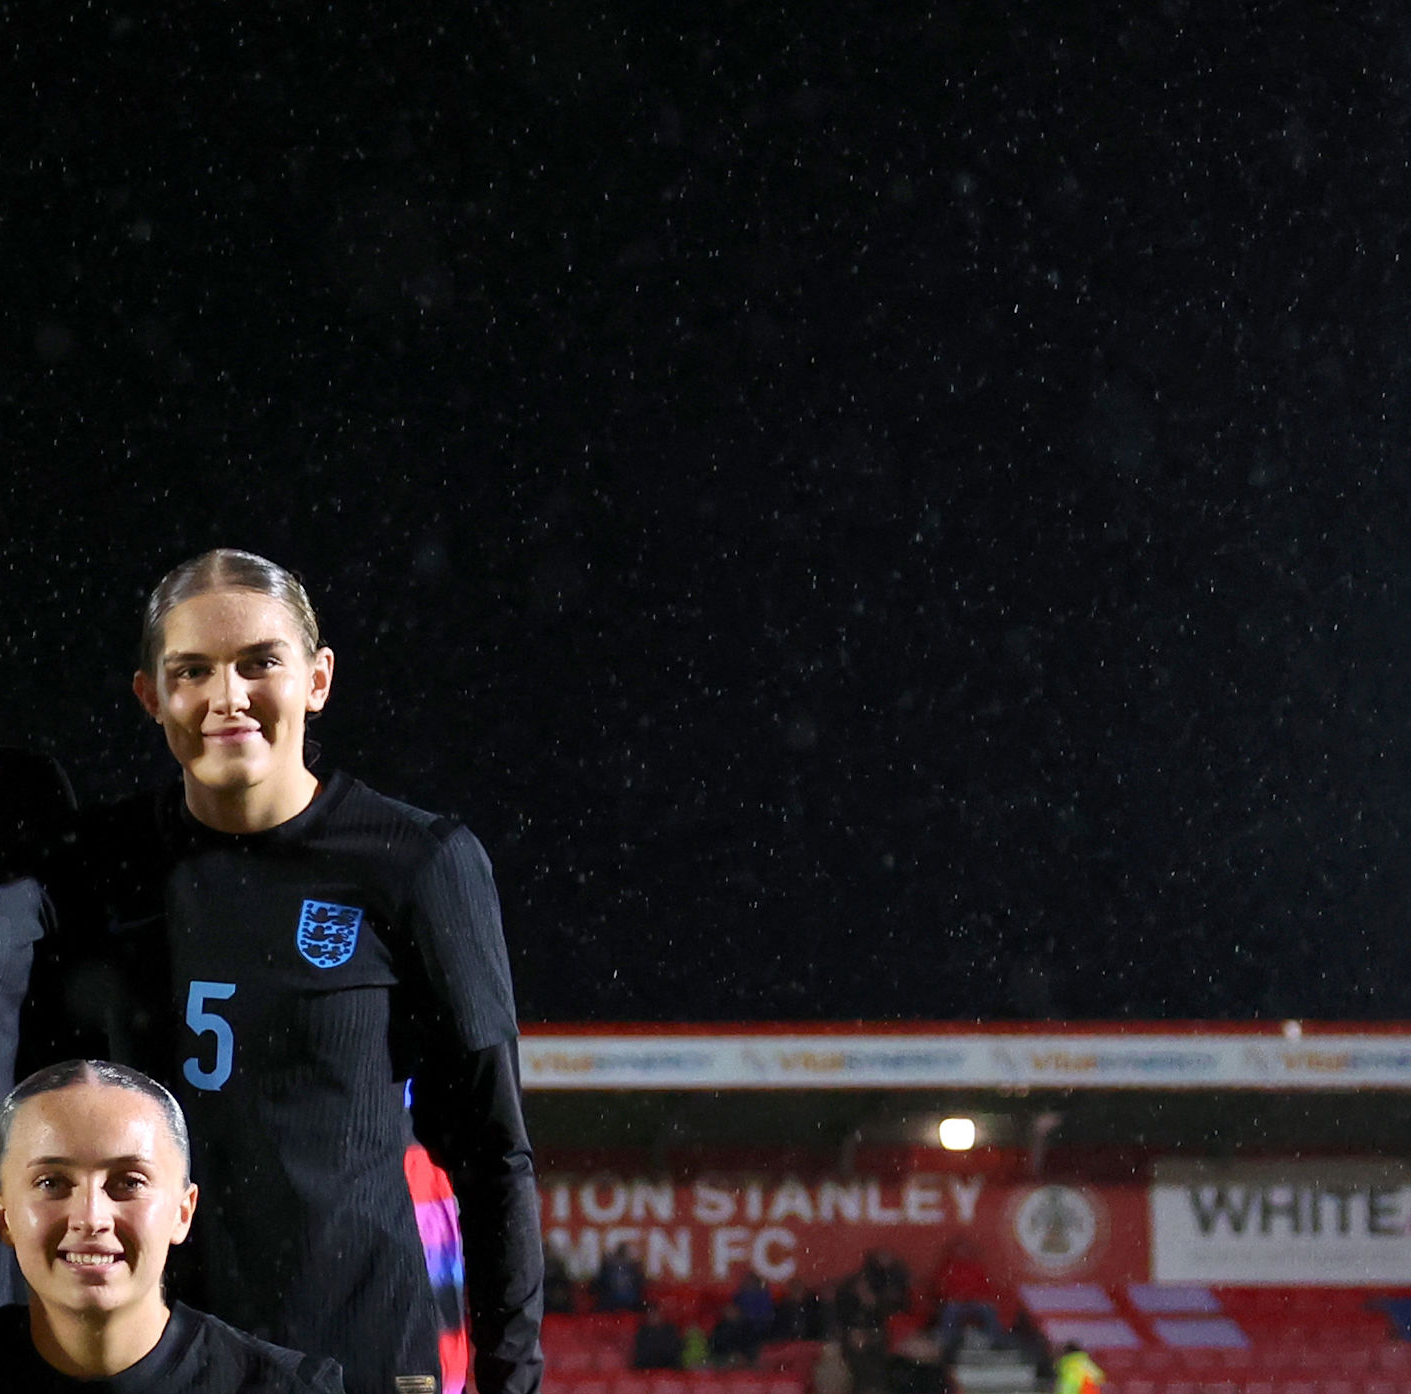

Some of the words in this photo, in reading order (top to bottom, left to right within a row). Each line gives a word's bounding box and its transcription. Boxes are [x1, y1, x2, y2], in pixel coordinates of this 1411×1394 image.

[183, 980, 237, 1092] 5
[692, 1170, 982, 1225] STANLEY
[1187, 1183, 1401, 1238] WHITE
[712, 1227, 798, 1283] FC
